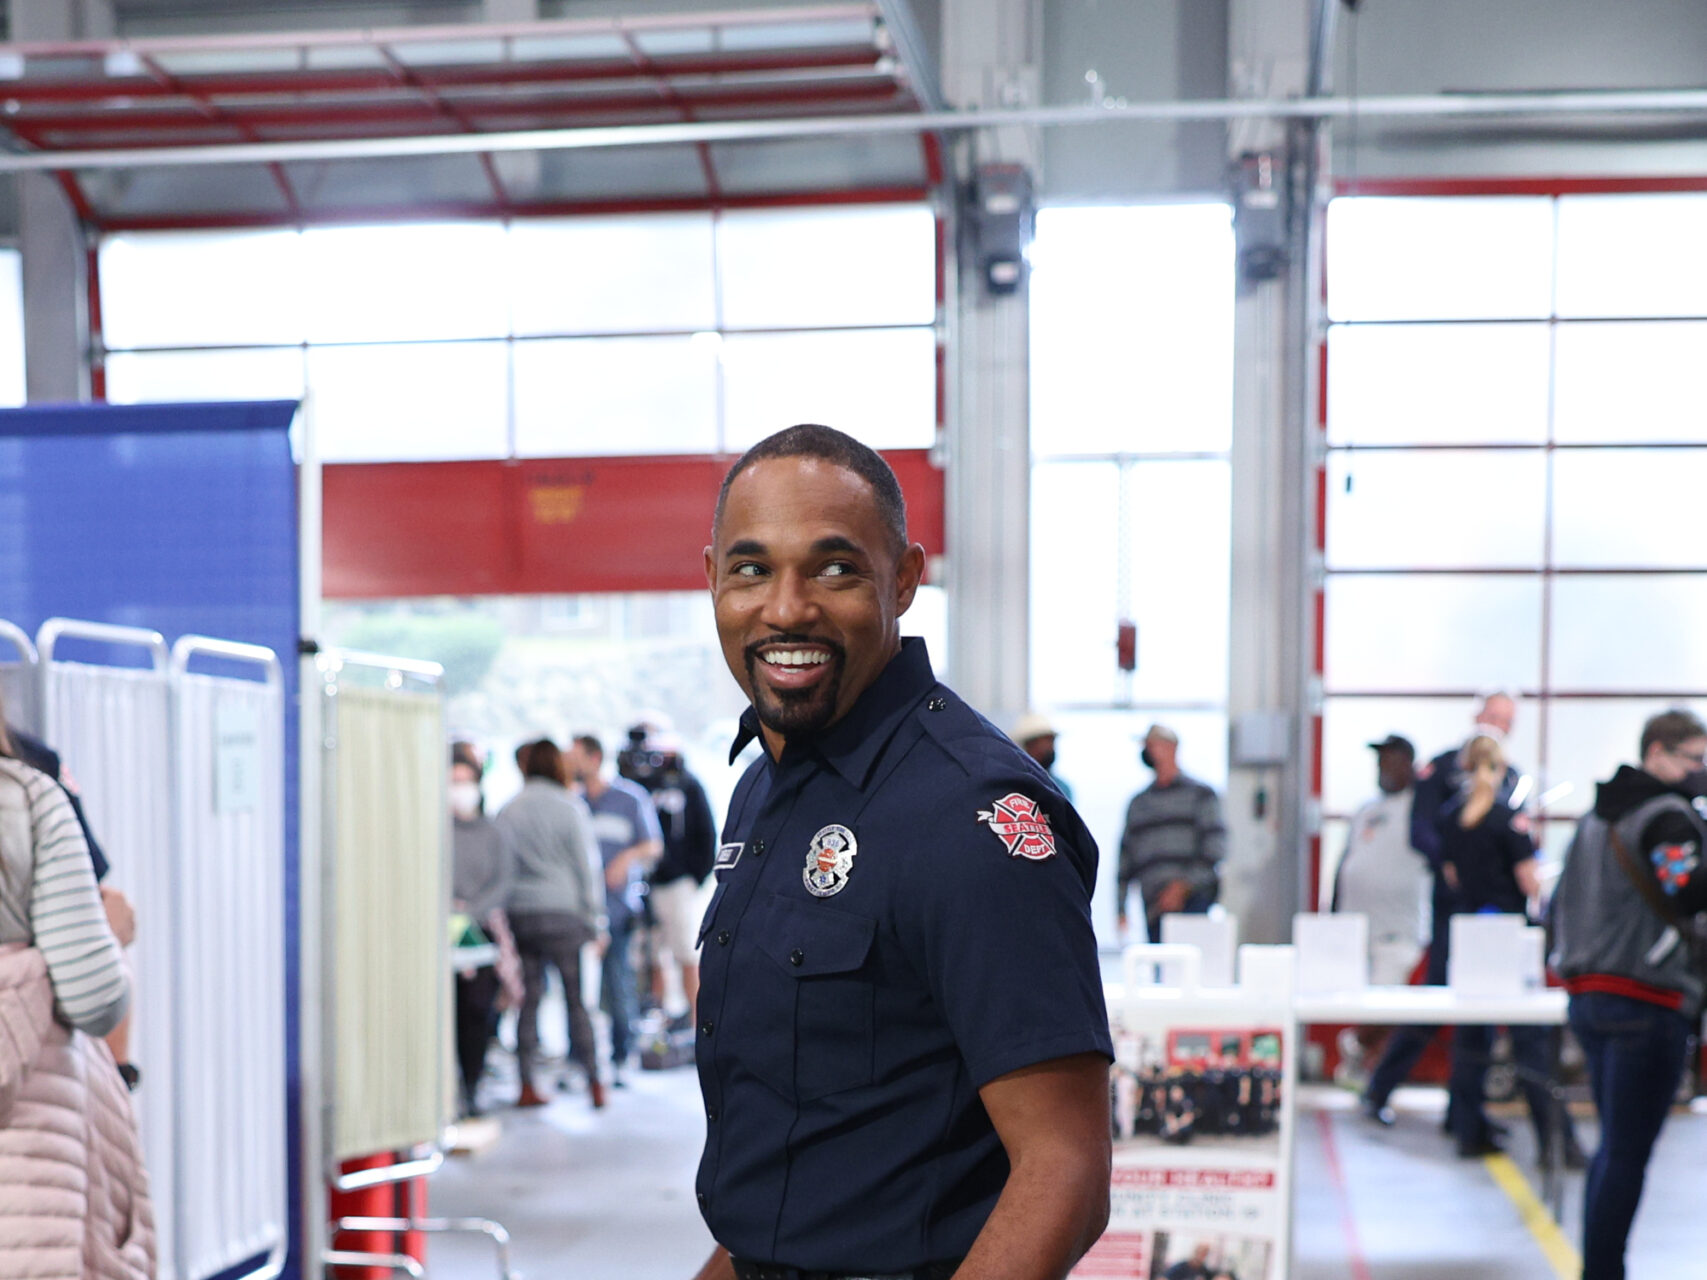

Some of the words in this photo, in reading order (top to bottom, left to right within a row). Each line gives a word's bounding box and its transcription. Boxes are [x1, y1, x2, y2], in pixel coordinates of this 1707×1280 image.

[1009, 798, 1030, 809] FIRE
[1003, 823, 1049, 834] SEATTLE
[1024, 843, 1046, 854] DEPT
